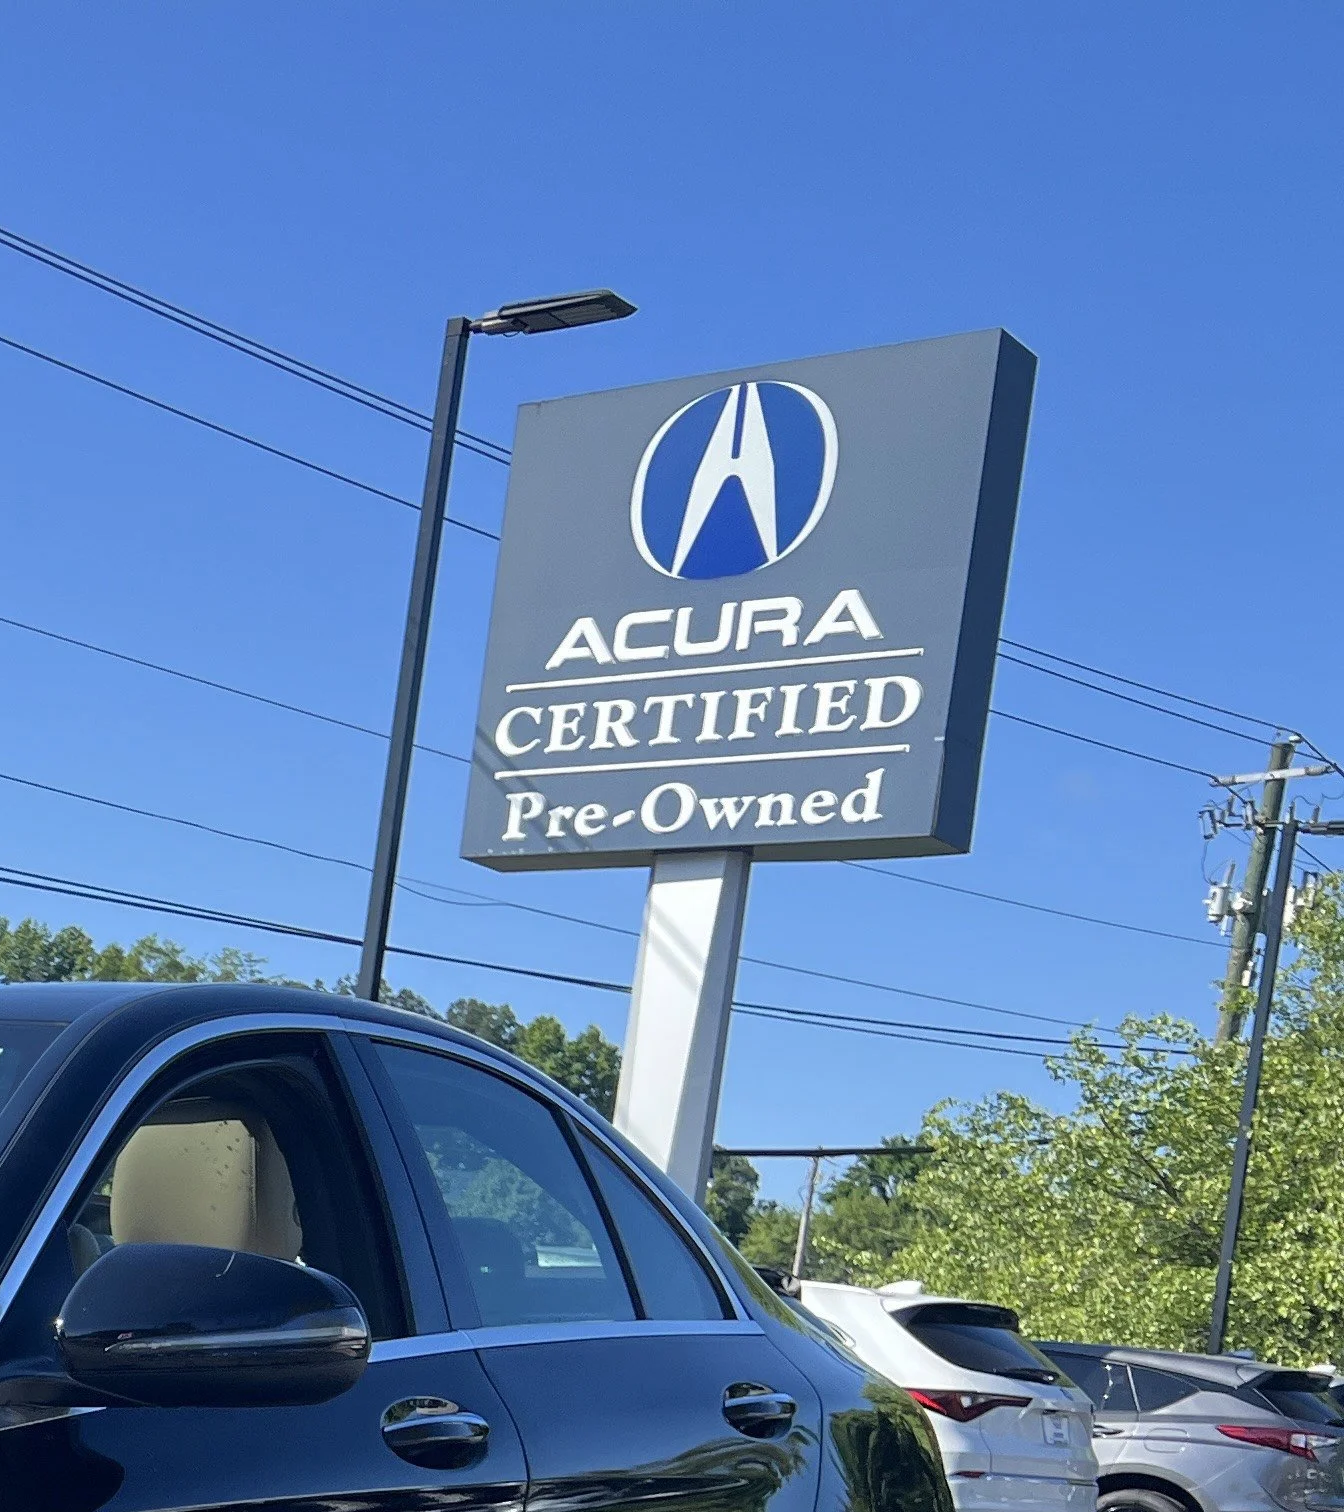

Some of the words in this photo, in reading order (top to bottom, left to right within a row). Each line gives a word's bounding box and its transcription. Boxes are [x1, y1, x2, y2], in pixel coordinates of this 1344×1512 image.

[545, 589, 884, 671] ACURA
[494, 674, 923, 758] CERTIFIED
[501, 767, 886, 842] Pre-Owned
